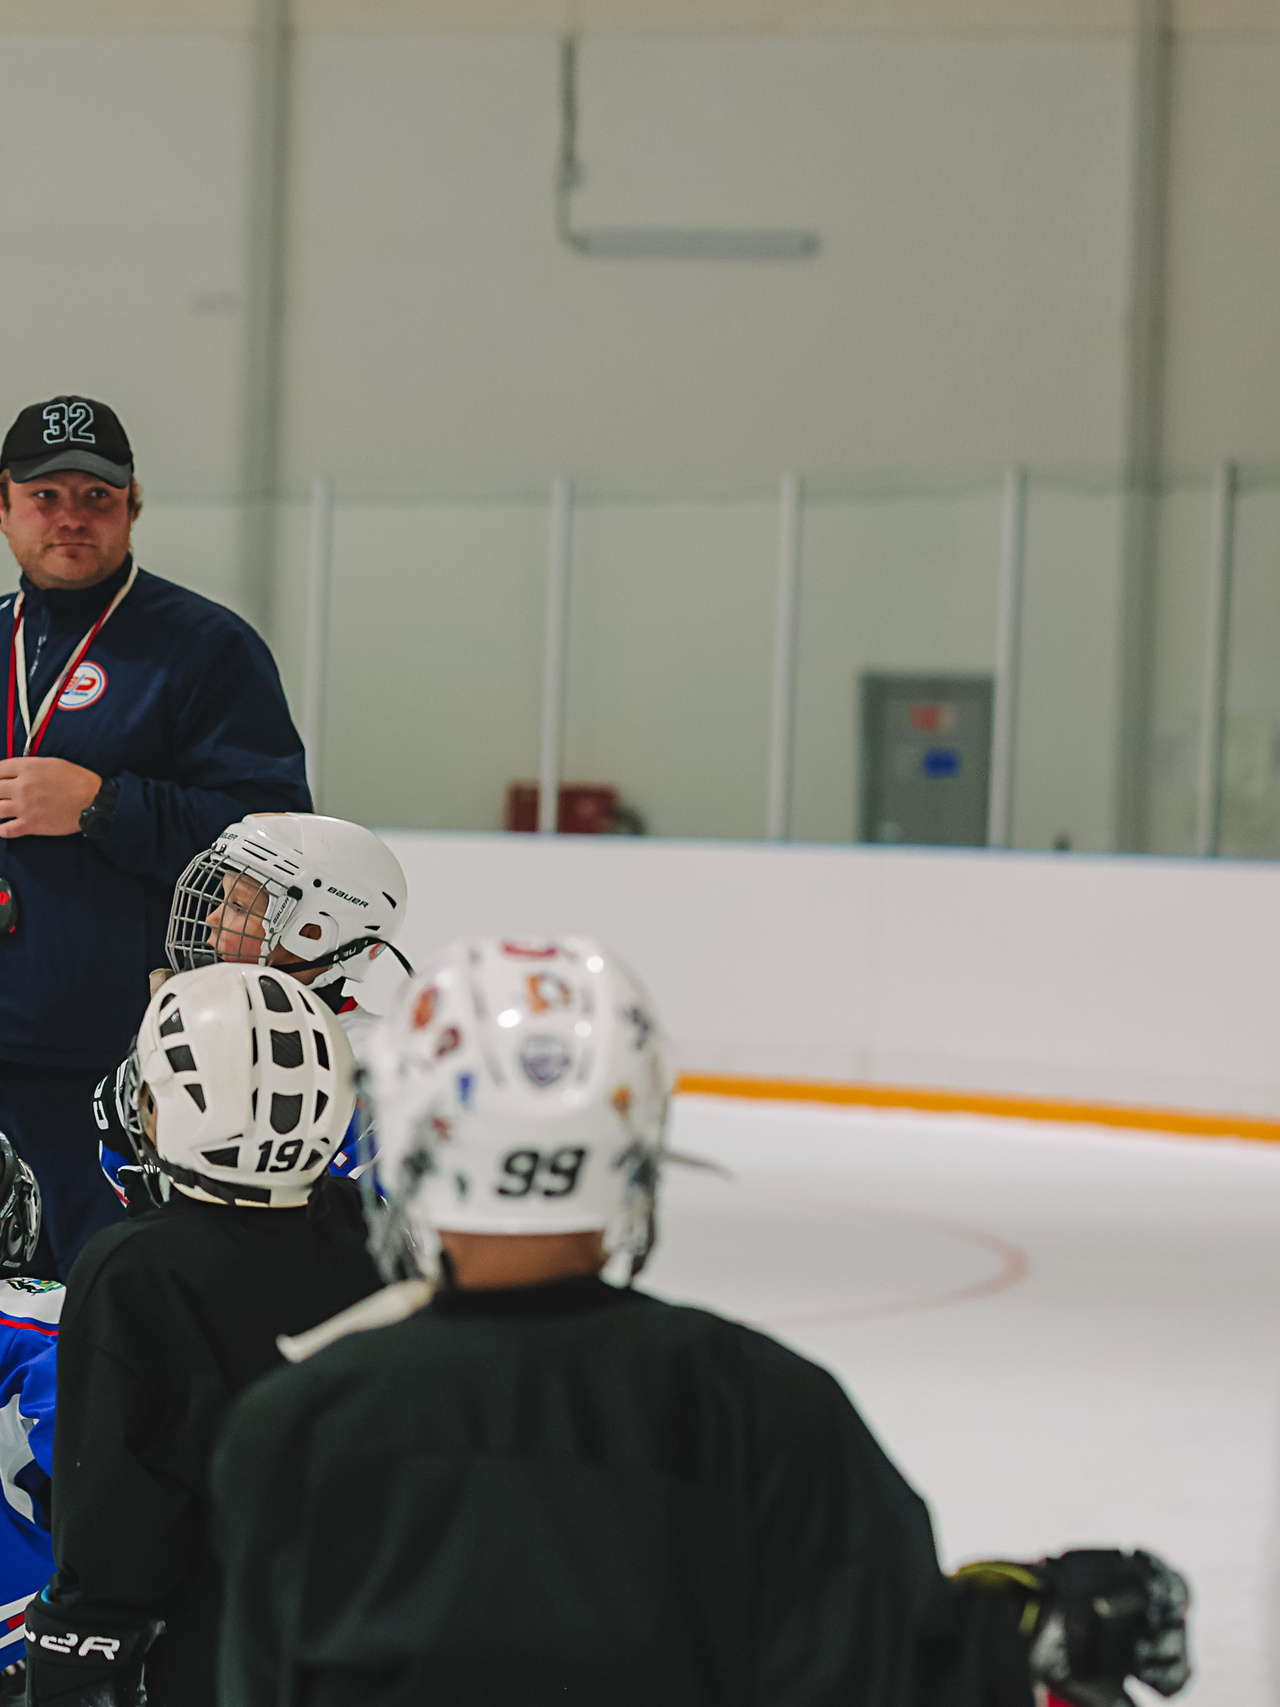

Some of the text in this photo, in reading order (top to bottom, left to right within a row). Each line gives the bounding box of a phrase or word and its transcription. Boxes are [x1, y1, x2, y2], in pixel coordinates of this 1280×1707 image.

[42, 401, 96, 444] 32
[327, 886, 370, 909] BAUER
[255, 1139, 304, 1173] 19
[496, 1146, 587, 1197] 99
